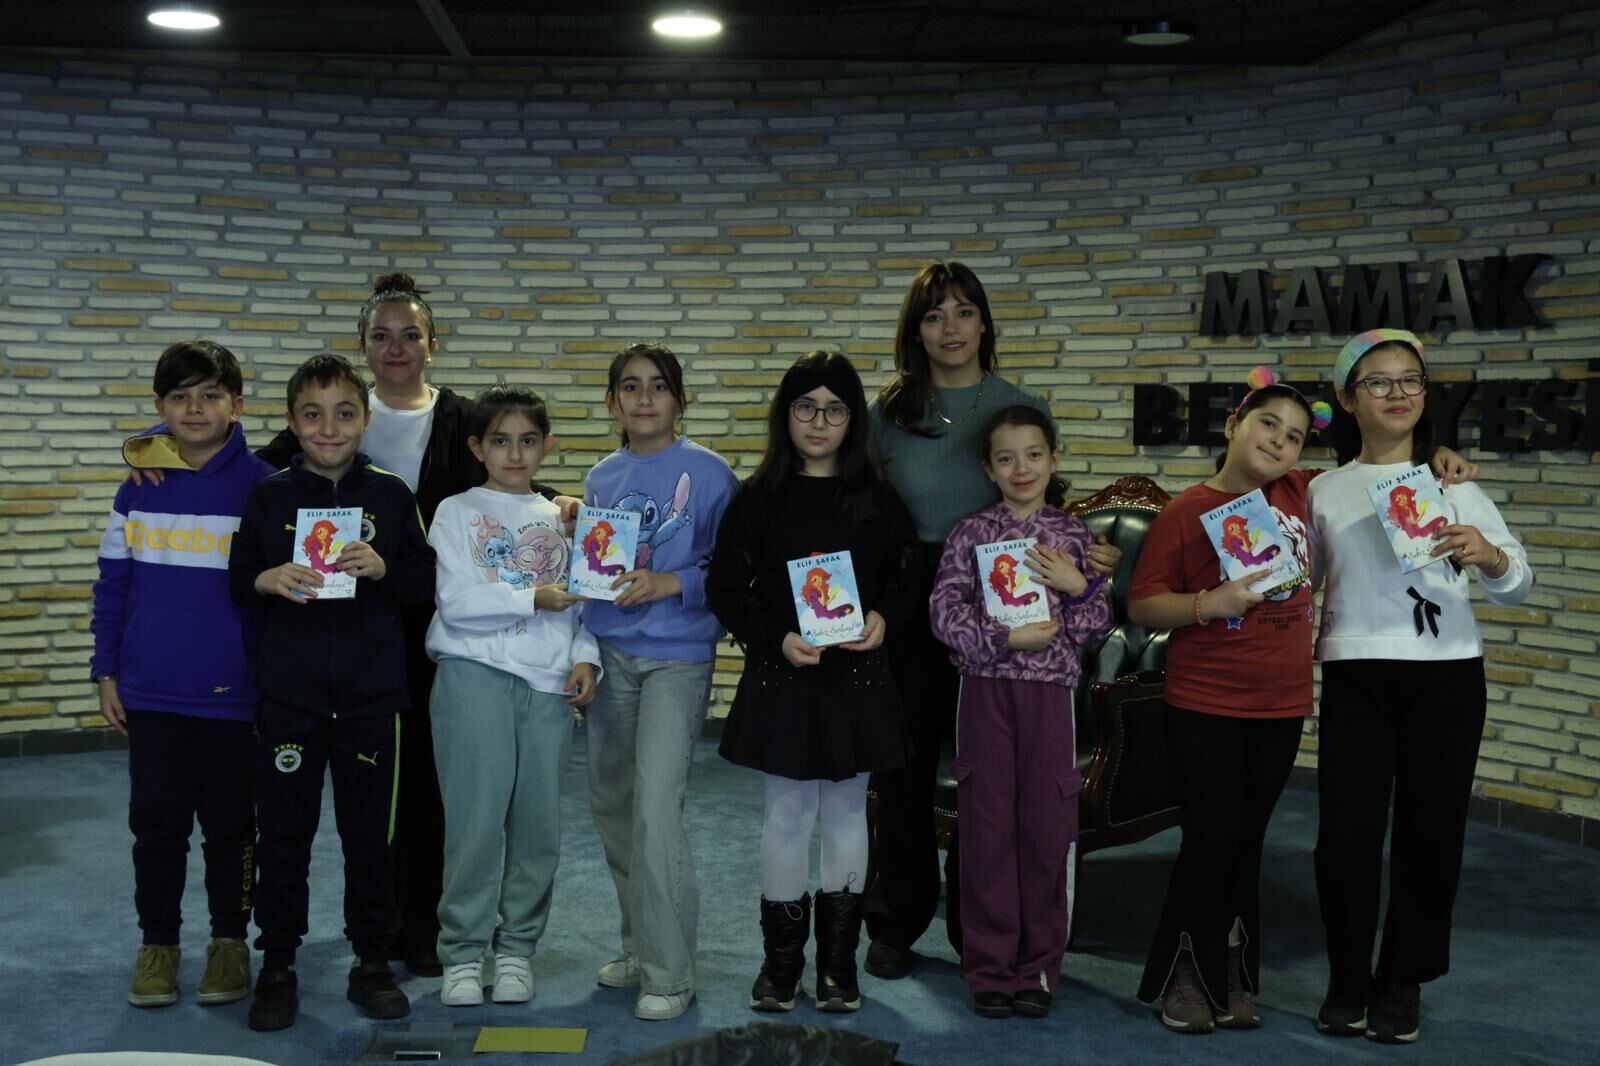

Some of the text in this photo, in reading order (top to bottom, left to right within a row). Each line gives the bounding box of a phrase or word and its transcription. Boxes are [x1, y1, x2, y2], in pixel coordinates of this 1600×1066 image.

[1200, 254, 1552, 336] MAMAK
[1396, 469, 1423, 483] ŞAFAK
[1227, 497, 1254, 513] ŞAFAK
[606, 512, 631, 520] ŞAFAK
[124, 520, 233, 557] Reebo
[816, 555, 841, 565] ŞAFAK
